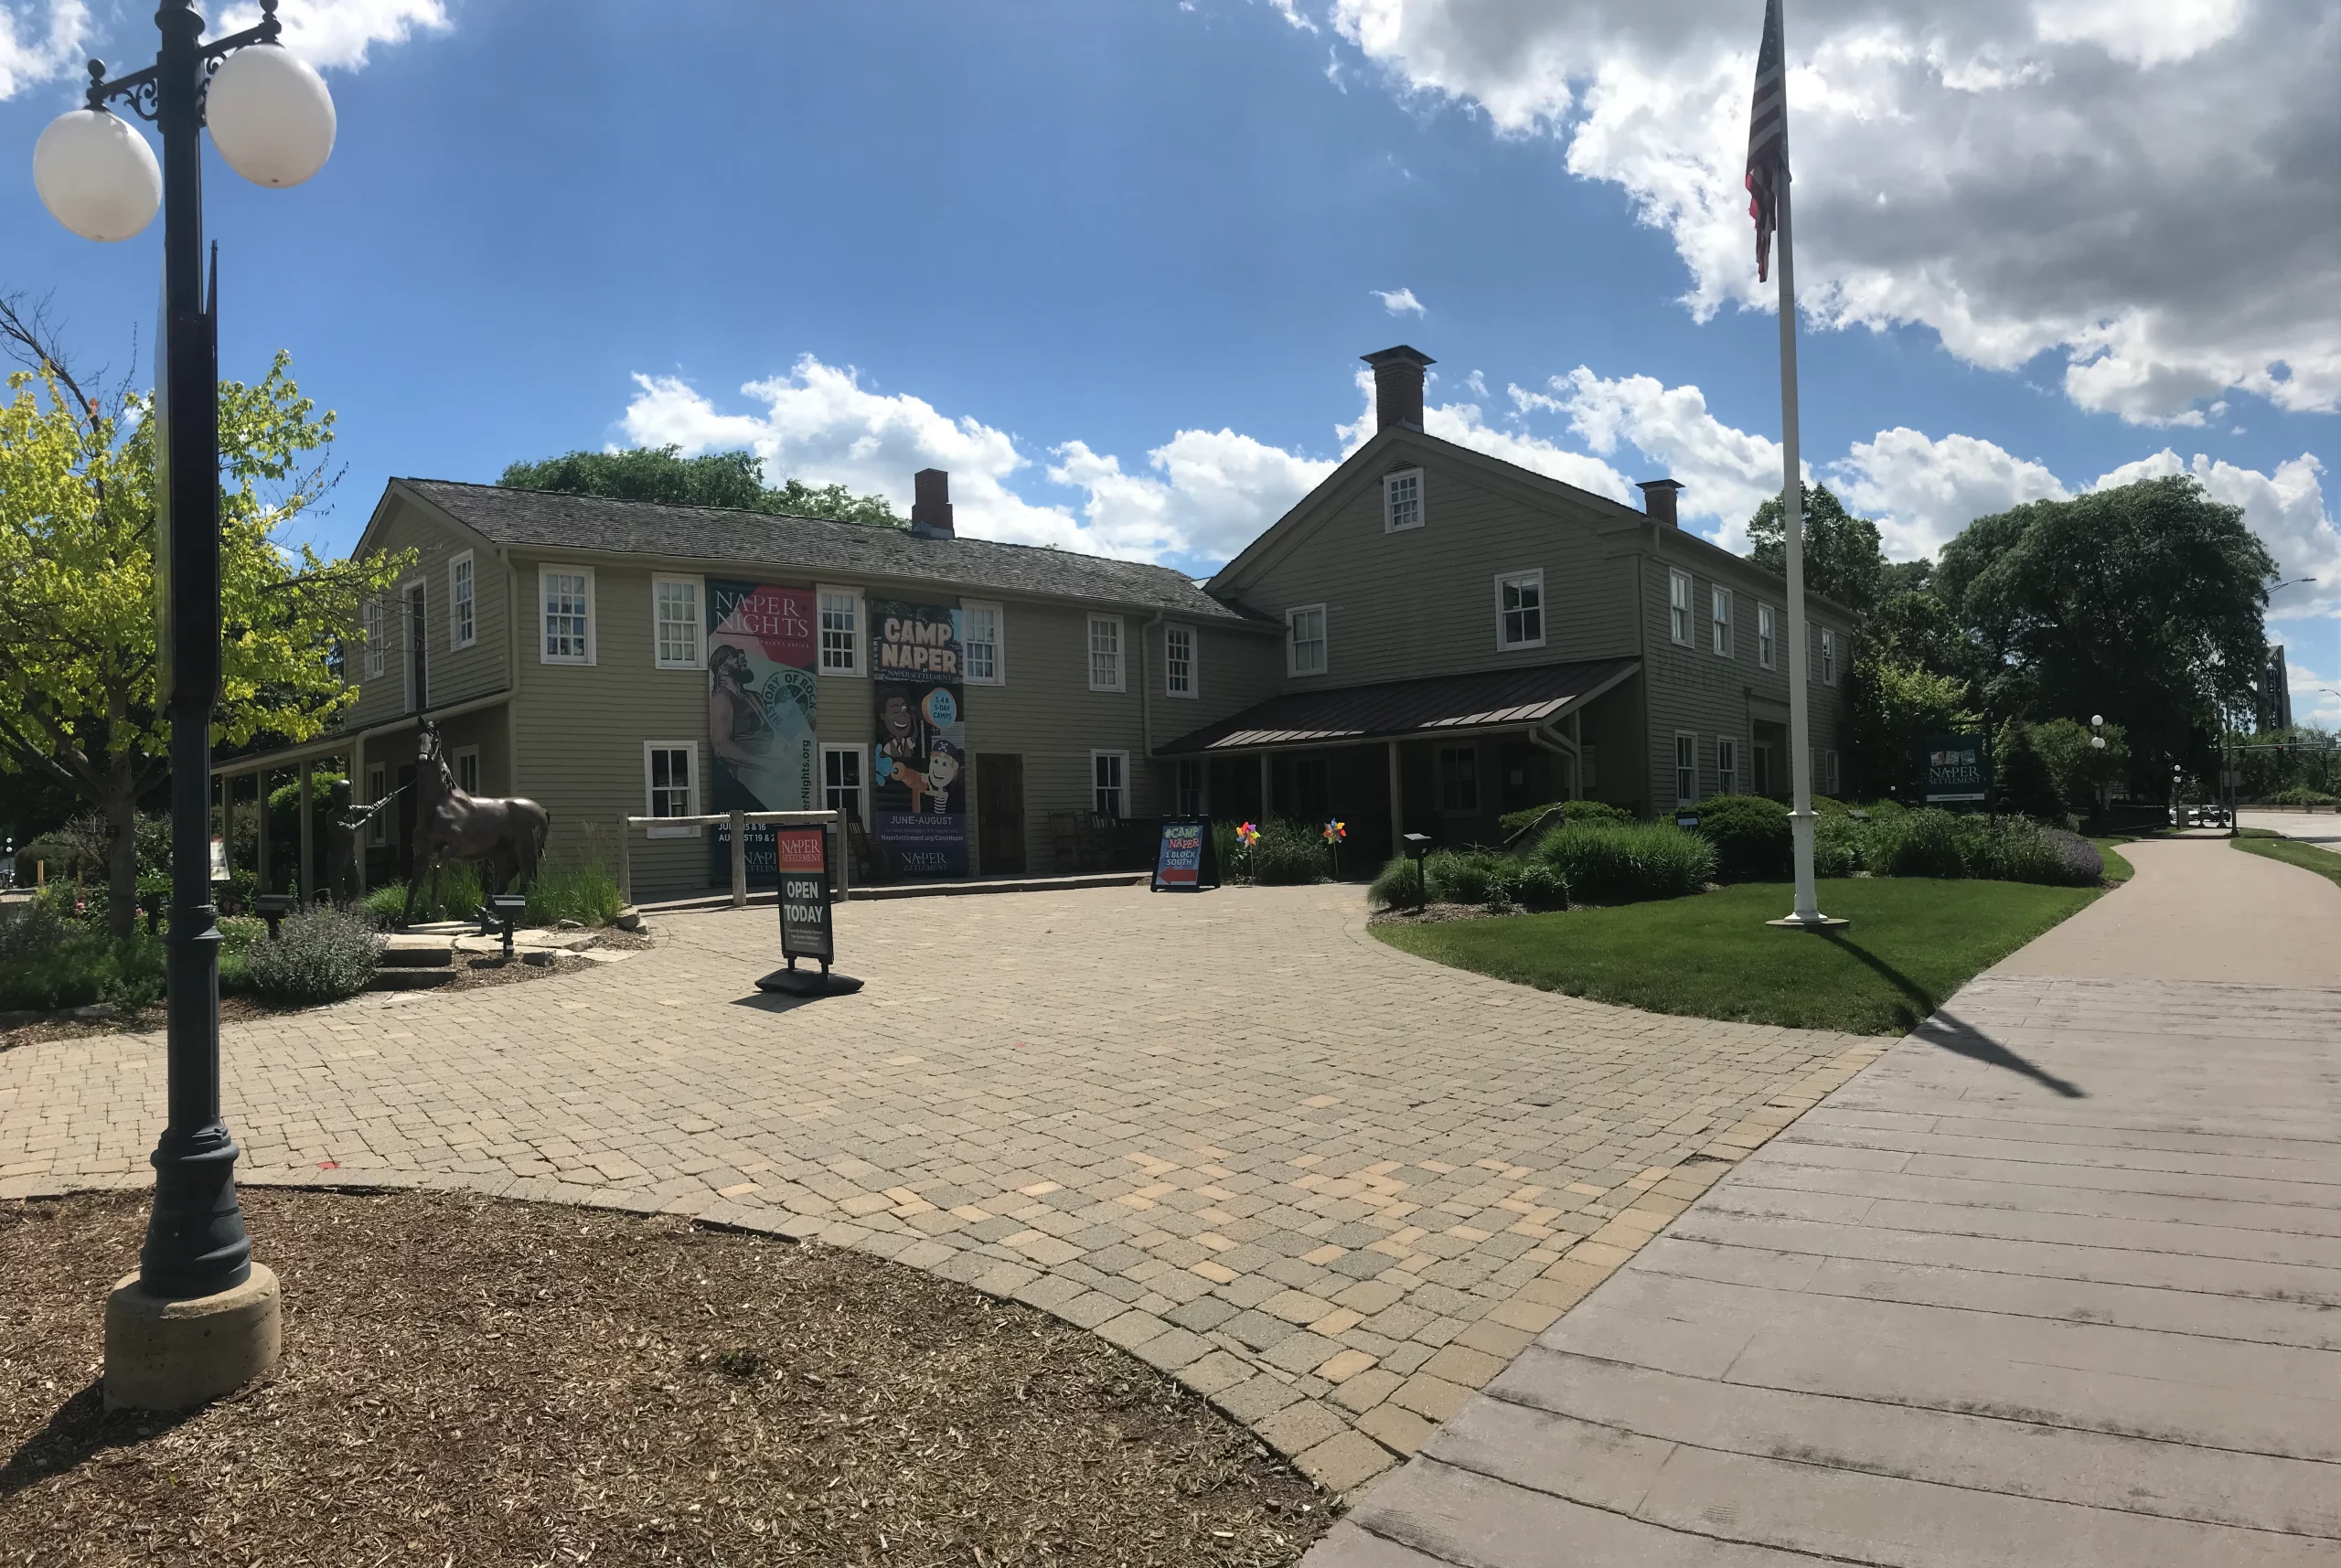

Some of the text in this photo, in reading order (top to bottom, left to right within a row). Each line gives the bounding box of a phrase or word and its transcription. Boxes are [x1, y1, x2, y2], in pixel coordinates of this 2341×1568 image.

[716, 591, 800, 618] NAPER
[716, 611, 809, 638] NIGHTS
[884, 618, 952, 647] CAMP
[882, 643, 957, 674] NAPER
[785, 674, 798, 684] OF
[933, 711, 952, 720] CAMPS
[1929, 766, 1981, 778] NAPER
[1929, 776, 1981, 784] SETTLEMENT
[890, 816, 953, 825] JUNE-AUGUST
[1164, 827, 1199, 838] #CAMP
[782, 838, 821, 854] NAPER
[1168, 837, 1200, 849] NAPER
[782, 853, 821, 862] SETTLEMENT
[903, 863, 947, 871] ETTLEMENT
[786, 881, 818, 899] OPEN
[785, 905, 823, 923] TODAY
